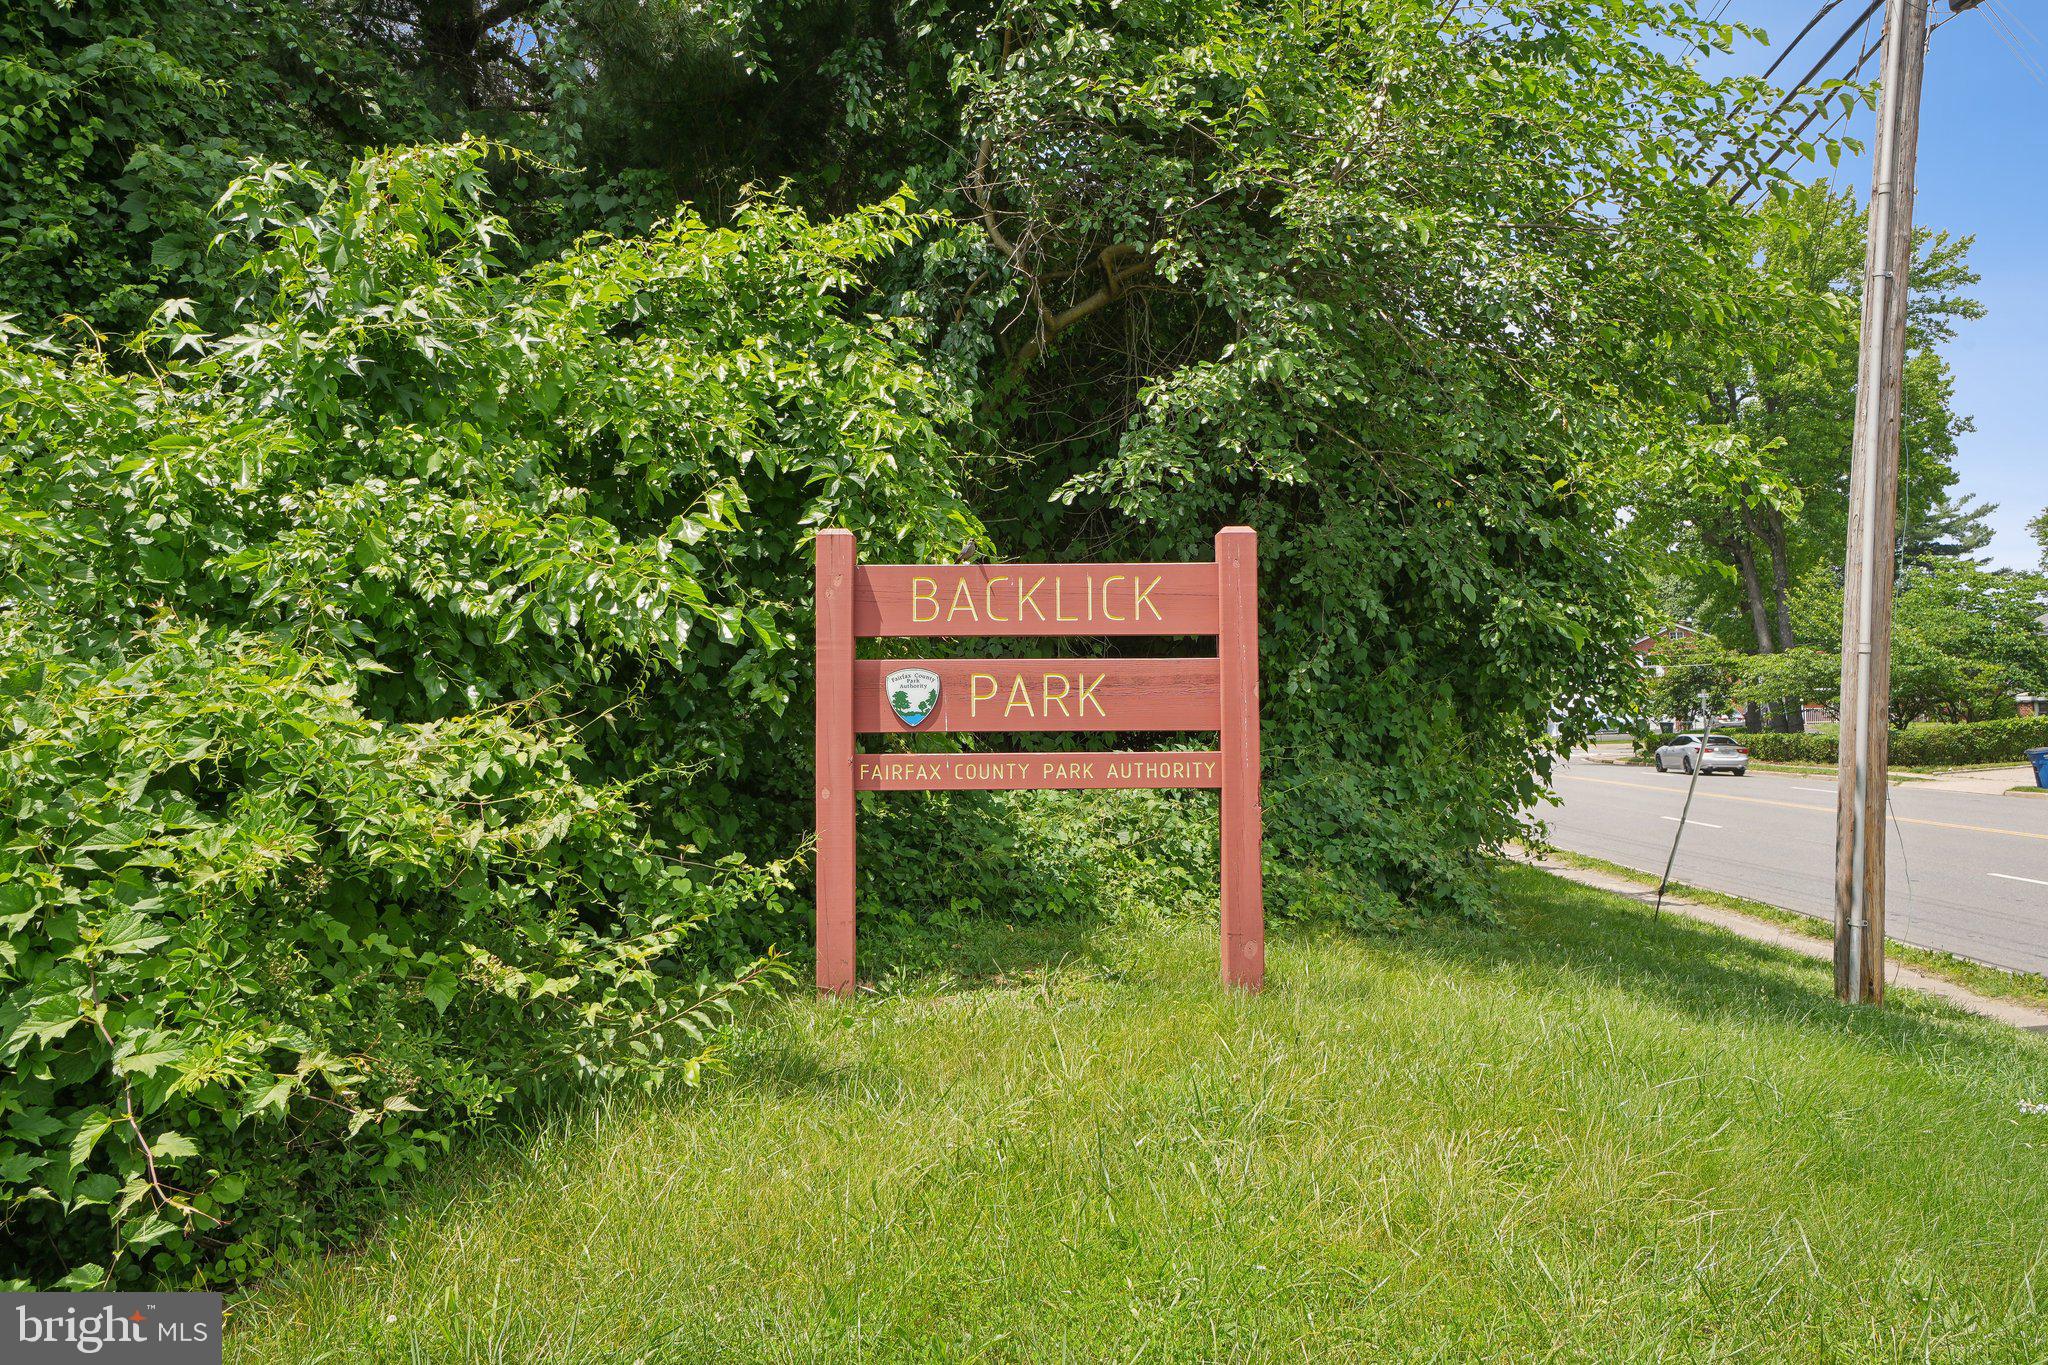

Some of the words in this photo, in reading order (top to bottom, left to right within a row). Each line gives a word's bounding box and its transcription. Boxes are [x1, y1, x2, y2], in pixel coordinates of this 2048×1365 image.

[911, 575, 1163, 622] BACKLICK
[891, 673, 911, 682] Fairfax
[914, 673, 936, 682] County
[970, 672, 1106, 718] PARK
[859, 763, 942, 781] FAIRFAX
[954, 763, 1030, 780] COUNTY
[1043, 762, 1094, 779] PARK
[1106, 761, 1216, 779] AUTHORITY
